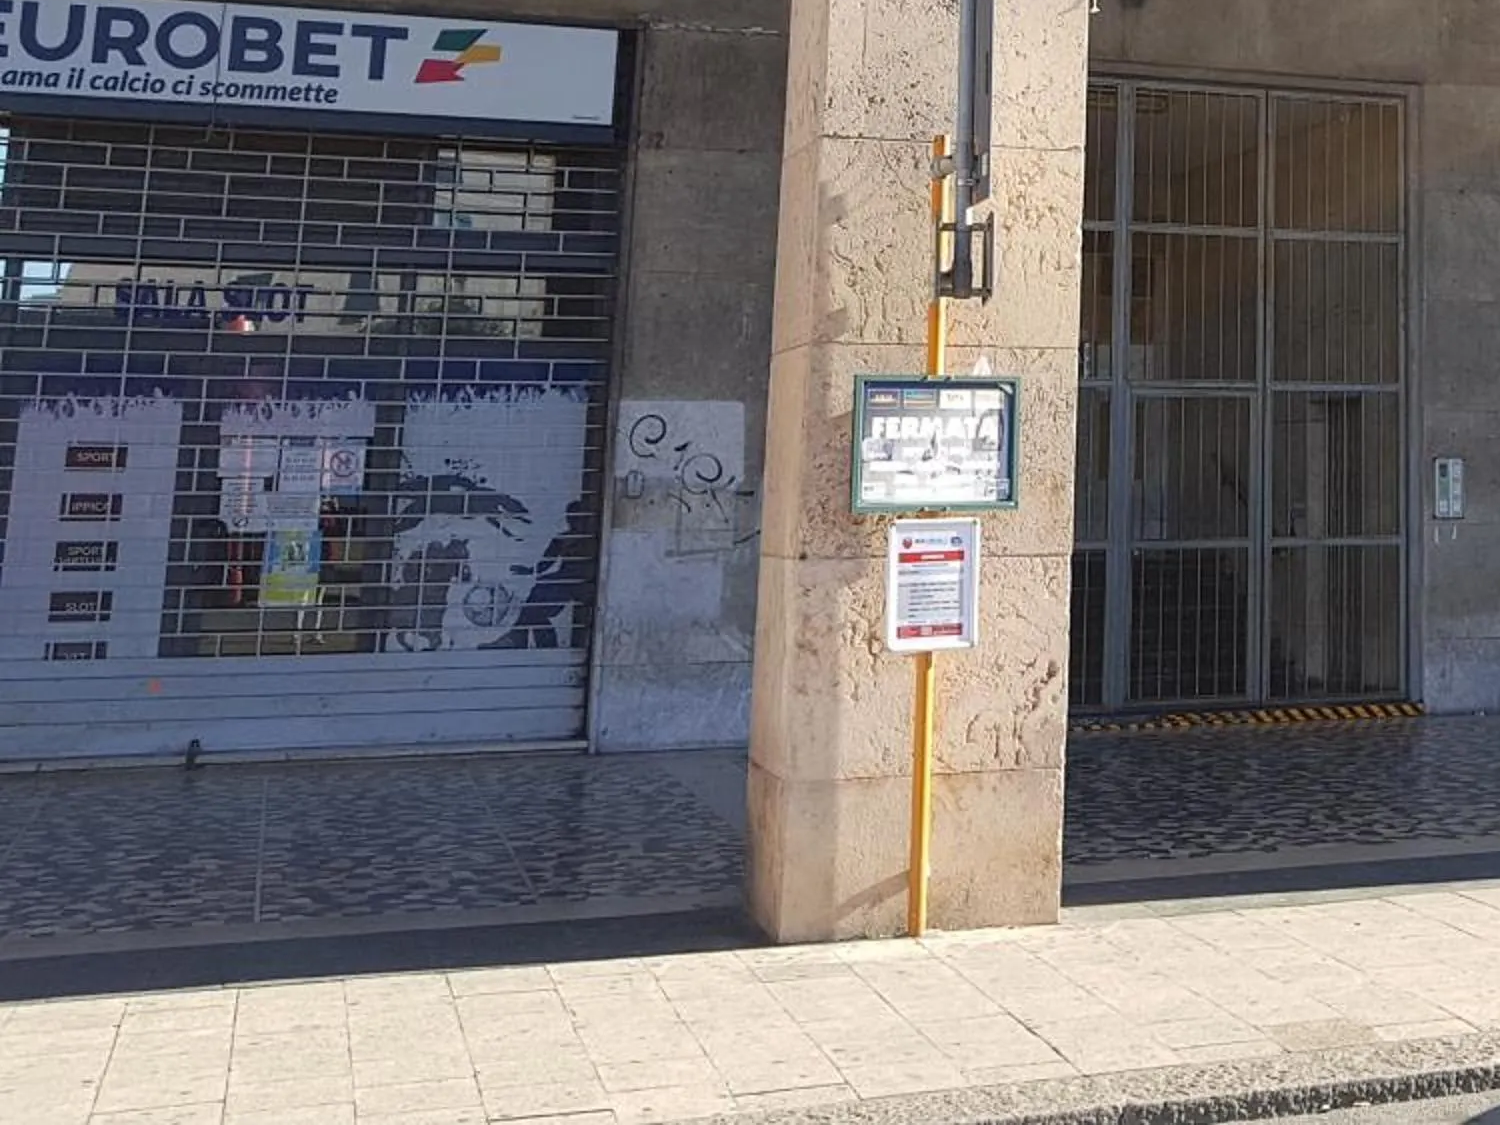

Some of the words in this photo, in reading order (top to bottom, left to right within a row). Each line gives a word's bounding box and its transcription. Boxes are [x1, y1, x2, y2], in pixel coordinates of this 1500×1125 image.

[0, 0, 409, 82] UROBET
[1, 70, 60, 89] ama
[66, 67, 85, 90] il
[89, 69, 164, 94] calcio
[172, 75, 194, 96] ci
[199, 78, 339, 104] scommette
[114, 277, 209, 319] SALA
[871, 415, 1000, 442] FERMATA
[76, 451, 119, 463] SPORT
